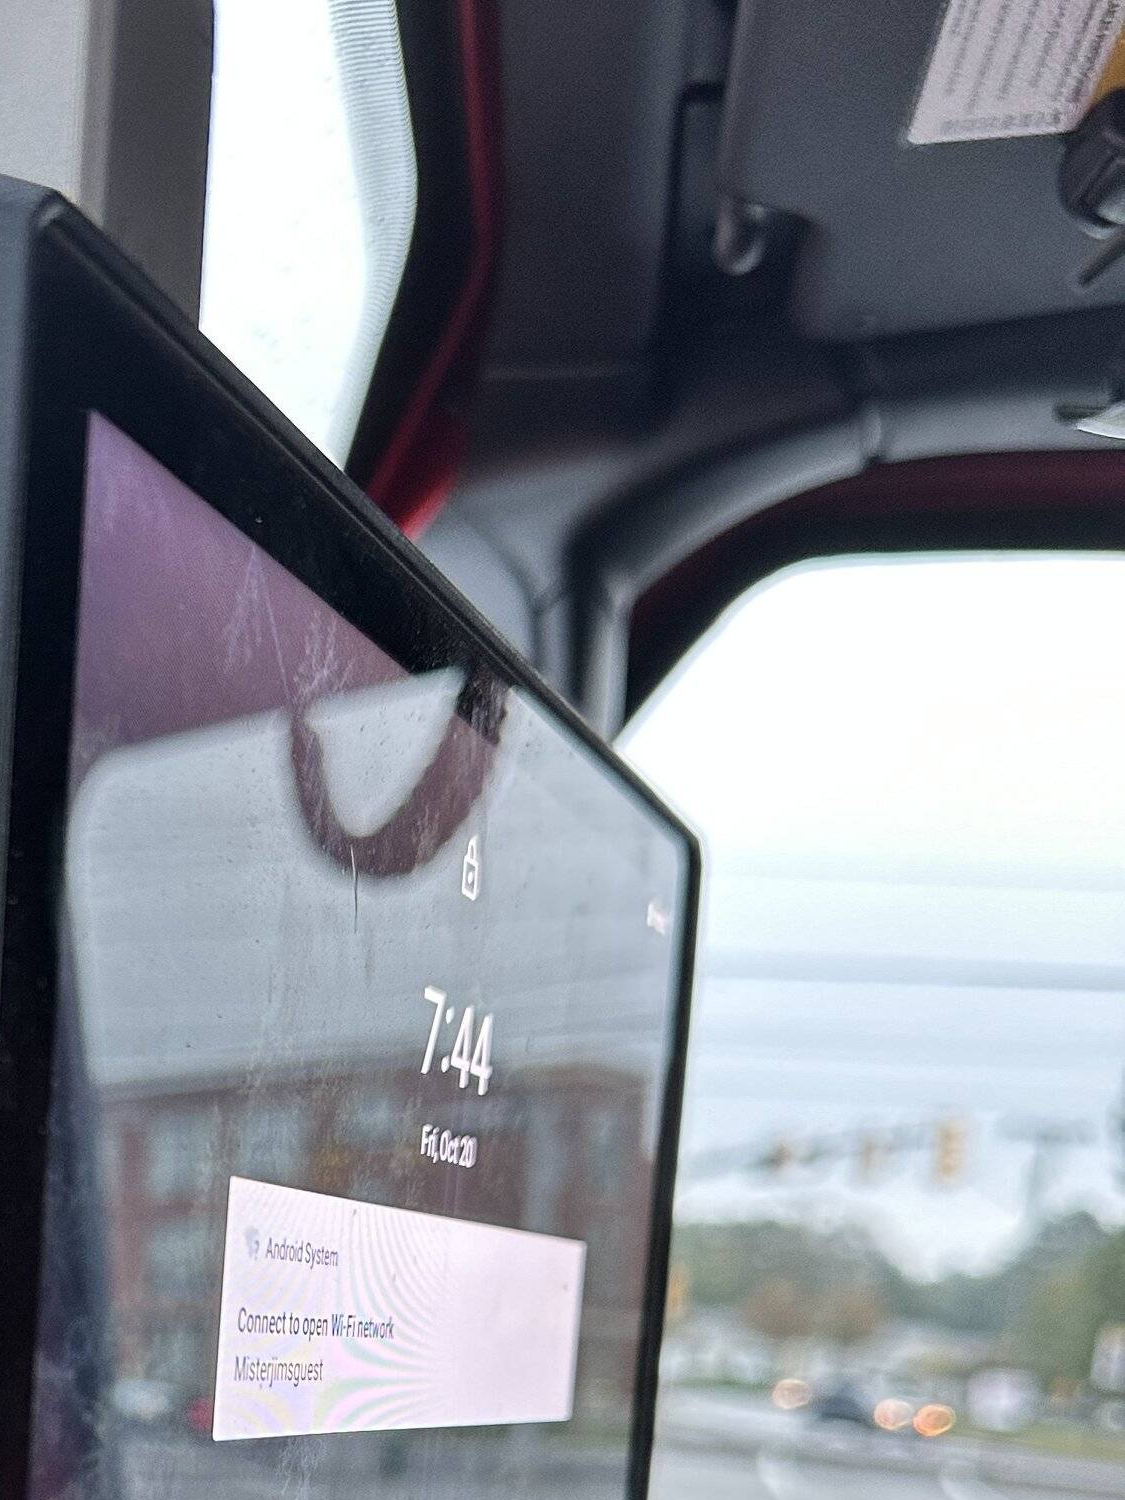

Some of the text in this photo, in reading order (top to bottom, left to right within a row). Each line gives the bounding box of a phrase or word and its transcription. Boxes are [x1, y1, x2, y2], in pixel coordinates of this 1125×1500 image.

[421, 985, 494, 1096] 7:44
[420, 1123, 477, 1168] Fri, Oct 20
[265, 1237, 340, 1269] Android System
[237, 1307, 395, 1343] Connect to open Wi-Fi network
[234, 1355, 324, 1388] Misterjimsguest
